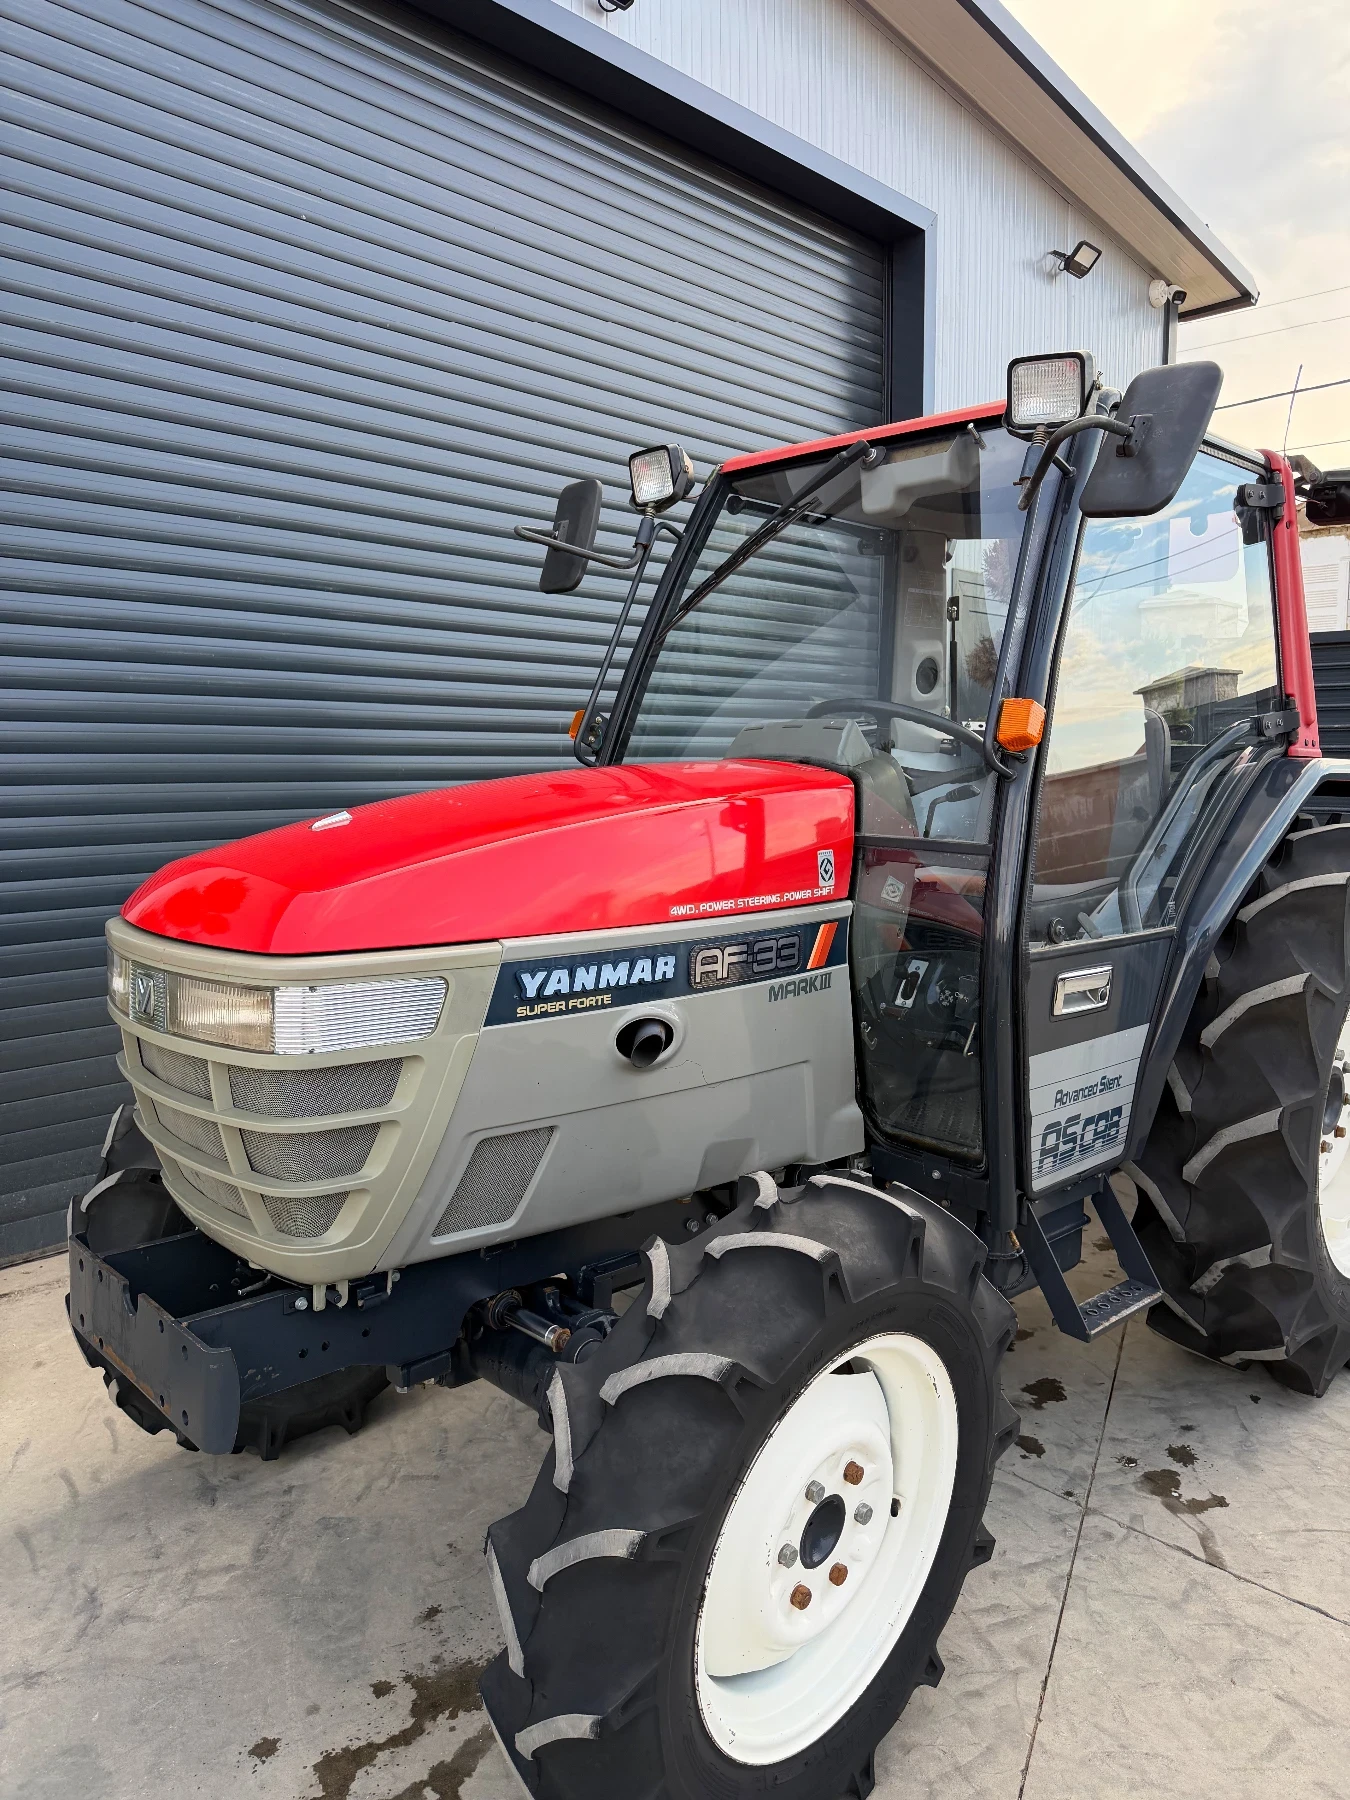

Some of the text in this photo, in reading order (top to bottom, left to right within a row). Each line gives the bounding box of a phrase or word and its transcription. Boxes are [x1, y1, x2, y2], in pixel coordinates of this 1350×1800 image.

[813, 886, 835, 898] SHIFT
[519, 954, 676, 999] YANMAR
[516, 993, 612, 1018] SUPER FORTE
[1053, 1082, 1099, 1109] Advanced
